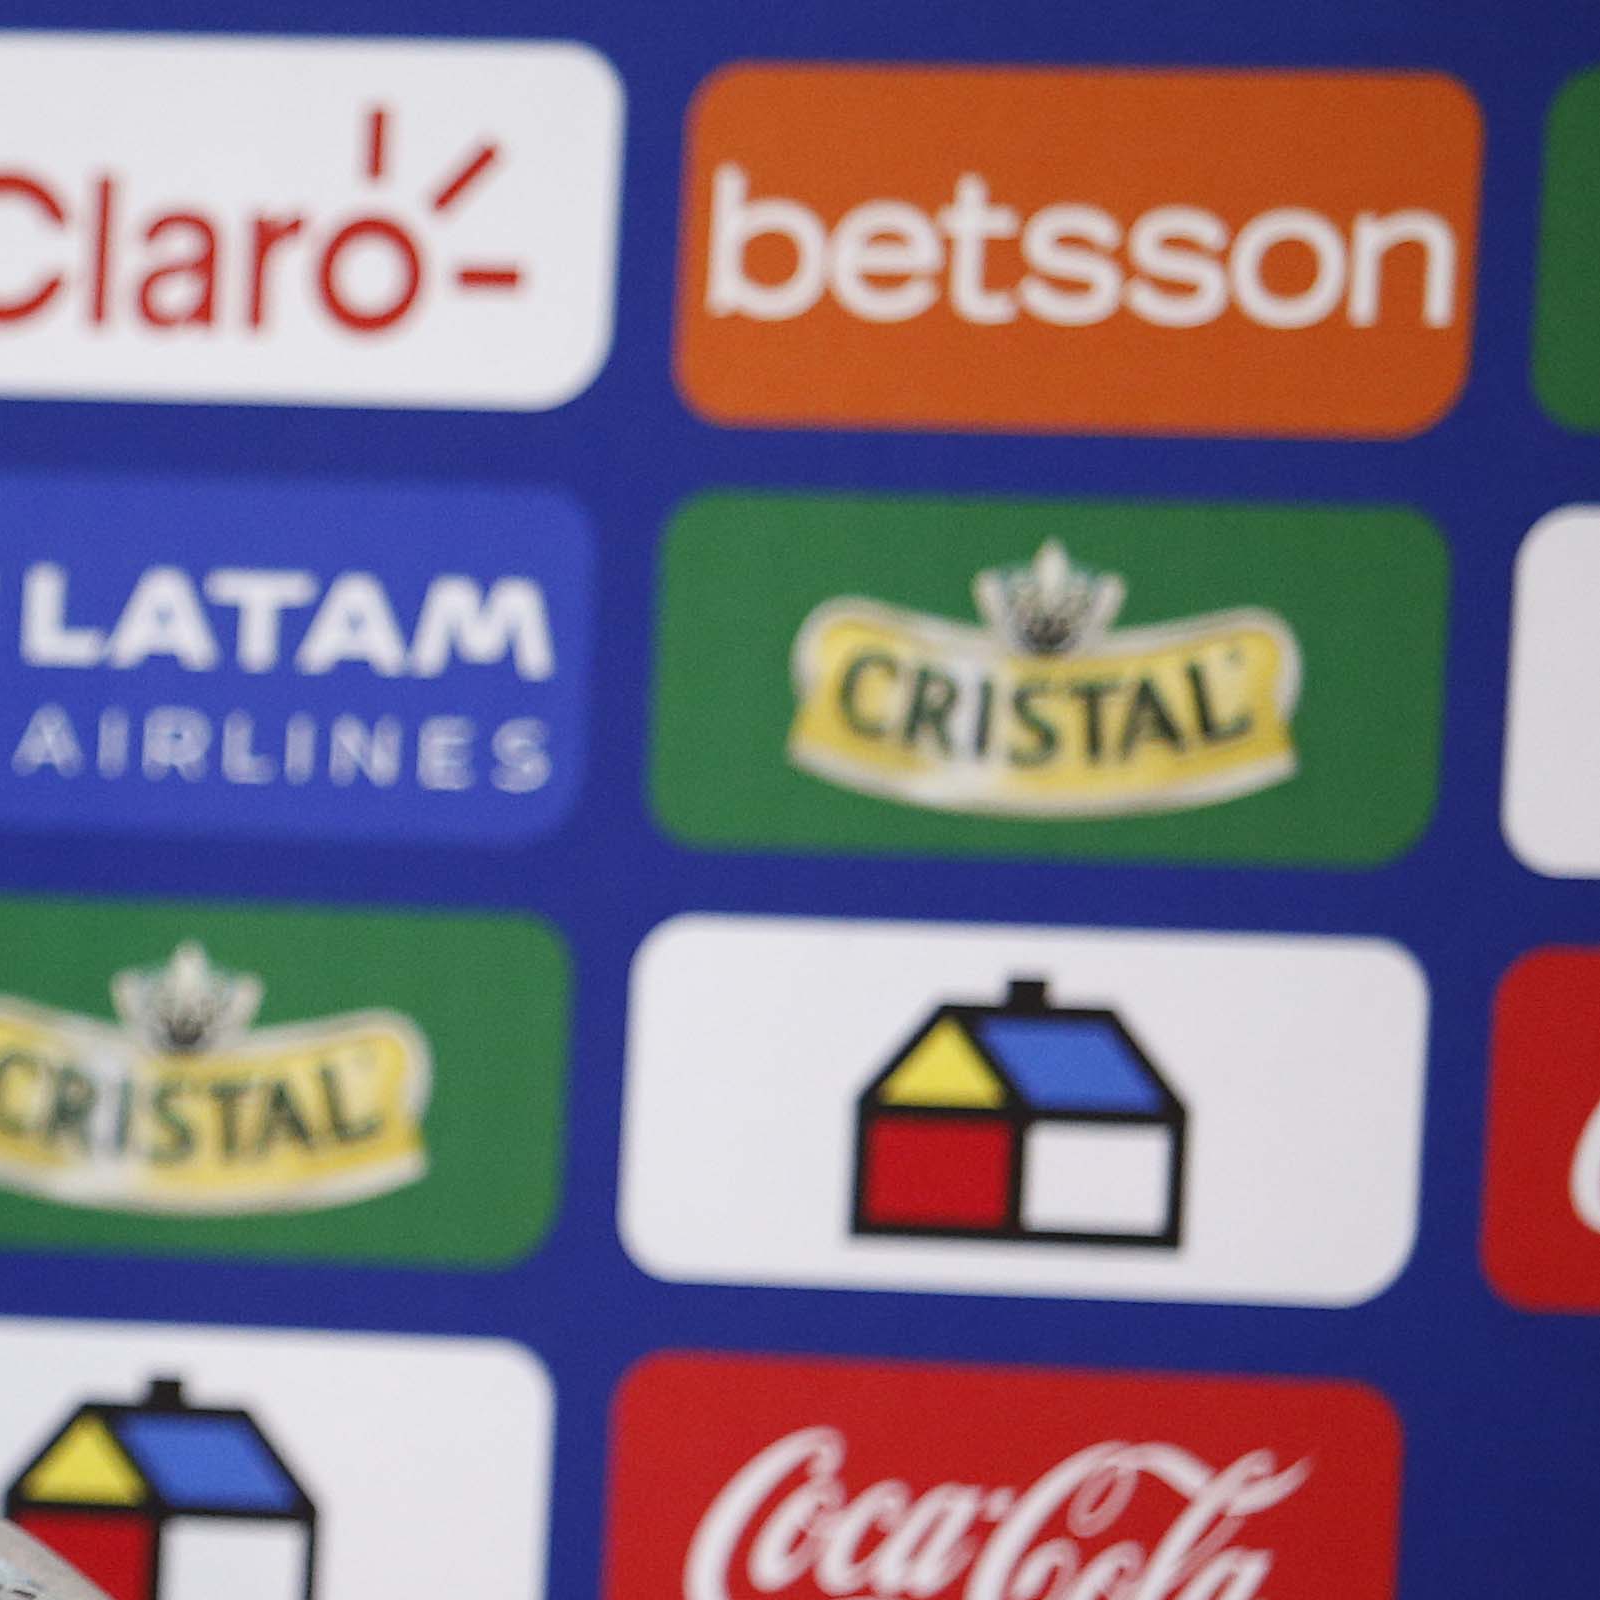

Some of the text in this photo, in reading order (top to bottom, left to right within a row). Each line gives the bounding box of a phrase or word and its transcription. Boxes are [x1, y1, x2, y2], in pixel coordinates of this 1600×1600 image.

[706, 160, 1458, 331] betsson
[17, 560, 556, 684] LATAM
[9, 702, 554, 796] AIRLINES
[834, 645, 1257, 772] CRISTAL
